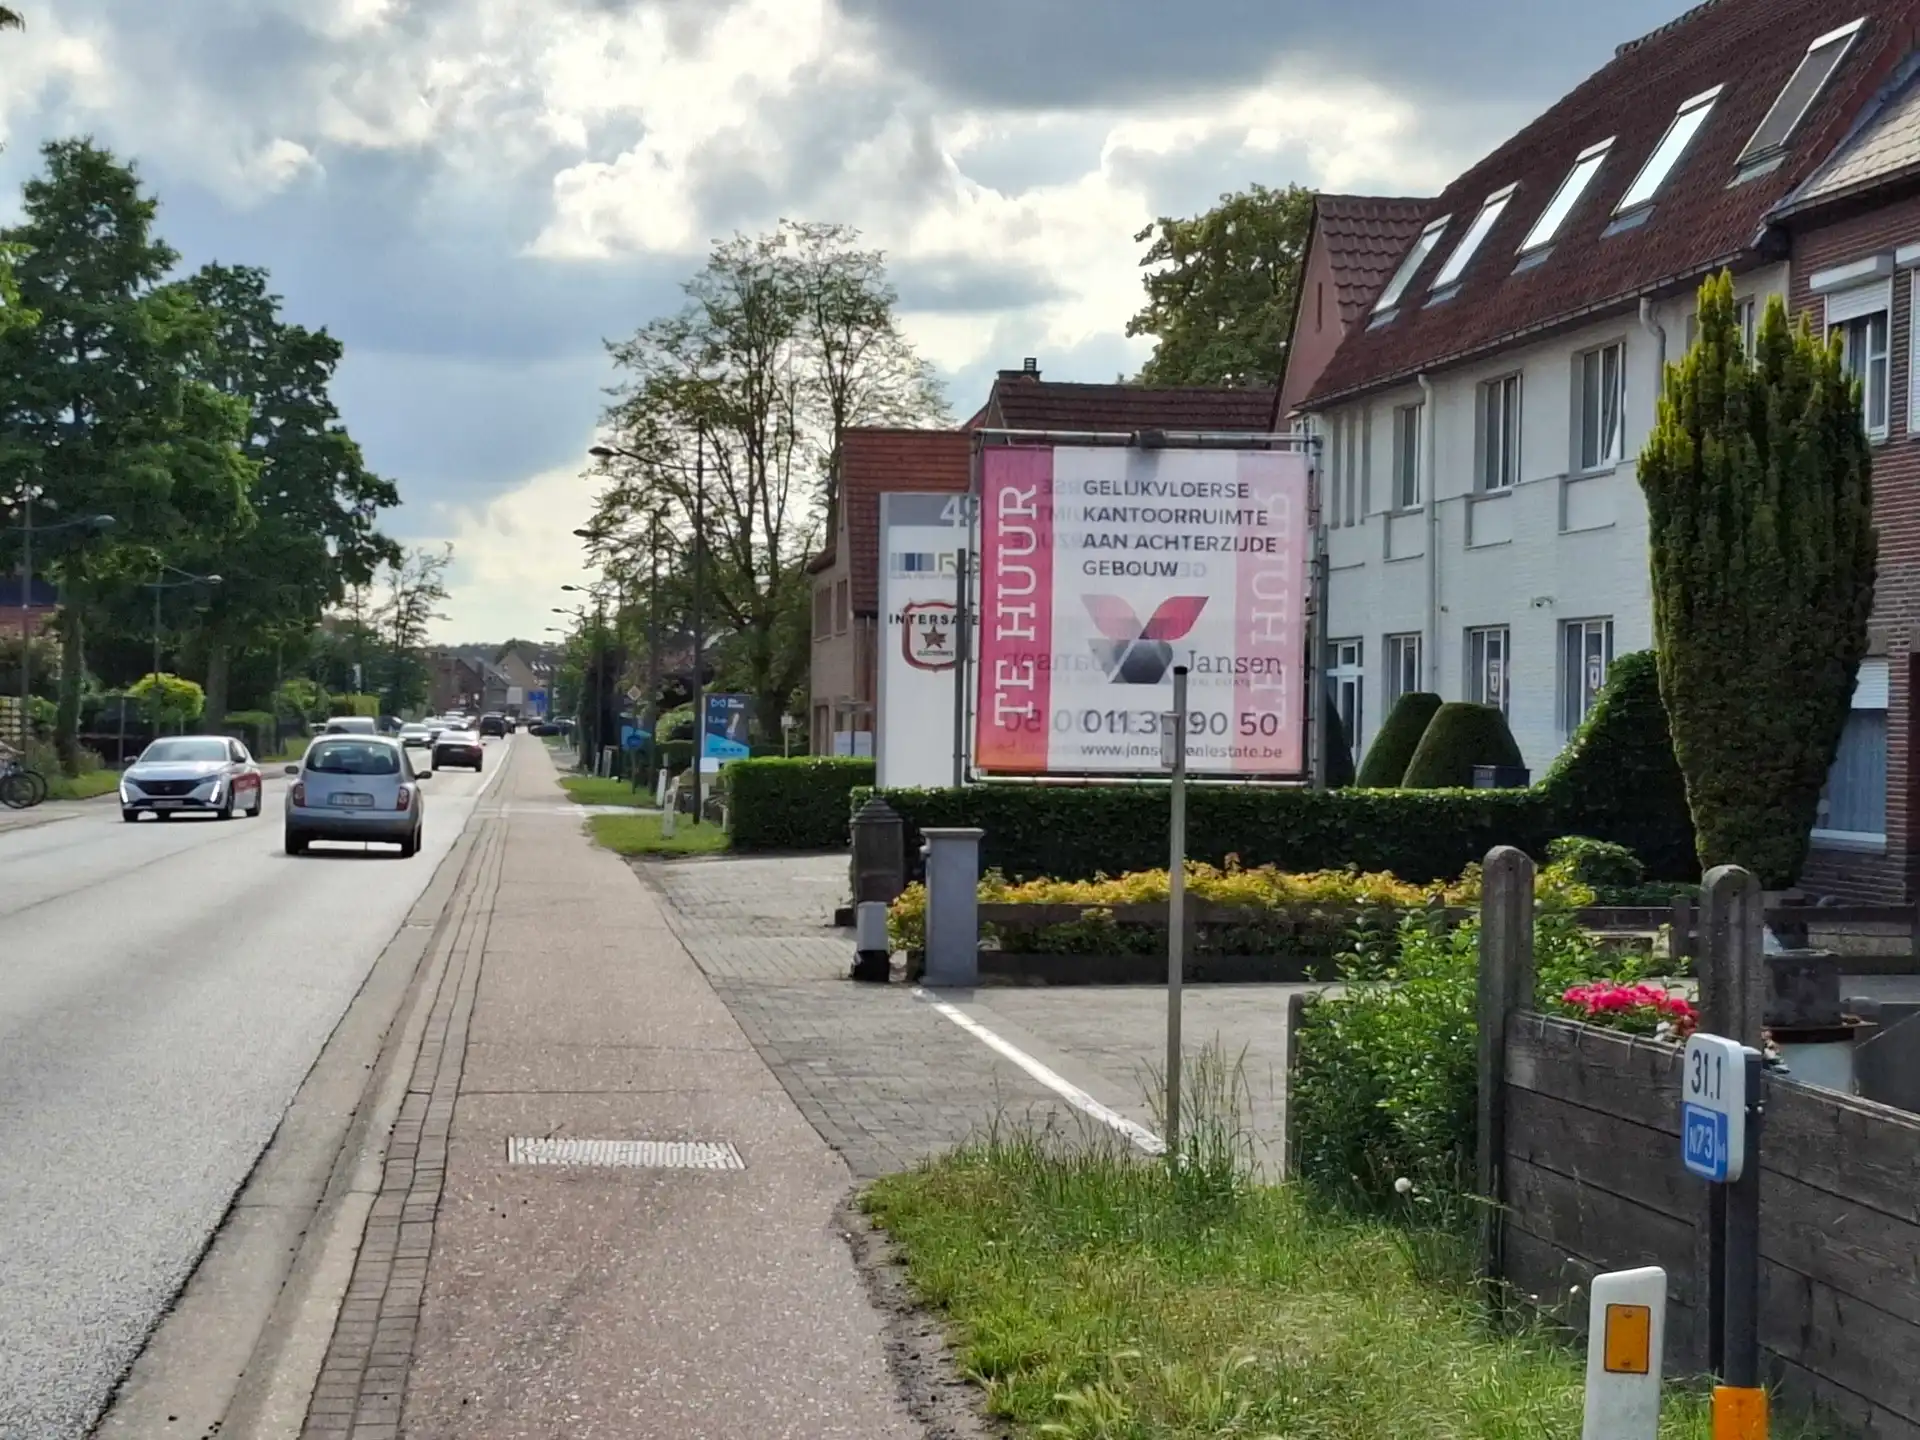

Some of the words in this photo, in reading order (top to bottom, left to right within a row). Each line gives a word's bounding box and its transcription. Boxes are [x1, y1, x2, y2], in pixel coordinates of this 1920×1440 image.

[1082, 480, 1250, 499] GELIJKVLOERSE
[1082, 506, 1268, 526] KANTOORRUIMTE
[1082, 533, 1128, 550] AAN
[1134, 534, 1278, 553] ACHTERZIJDE
[996, 484, 1037, 641] HUUR
[1082, 560, 1179, 578] GEBOUW
[888, 613, 980, 626] INTERSAE
[1186, 650, 1283, 675] Jansen
[994, 660, 1034, 726] TE
[1083, 709, 1129, 735] 011
[1188, 711, 1229, 736] 90
[1239, 712, 1279, 737] 50
[1080, 742, 1284, 760] www.jansealestate.be
[1691, 1049, 1722, 1100] 31.1
[1689, 1123, 1713, 1160] N73
